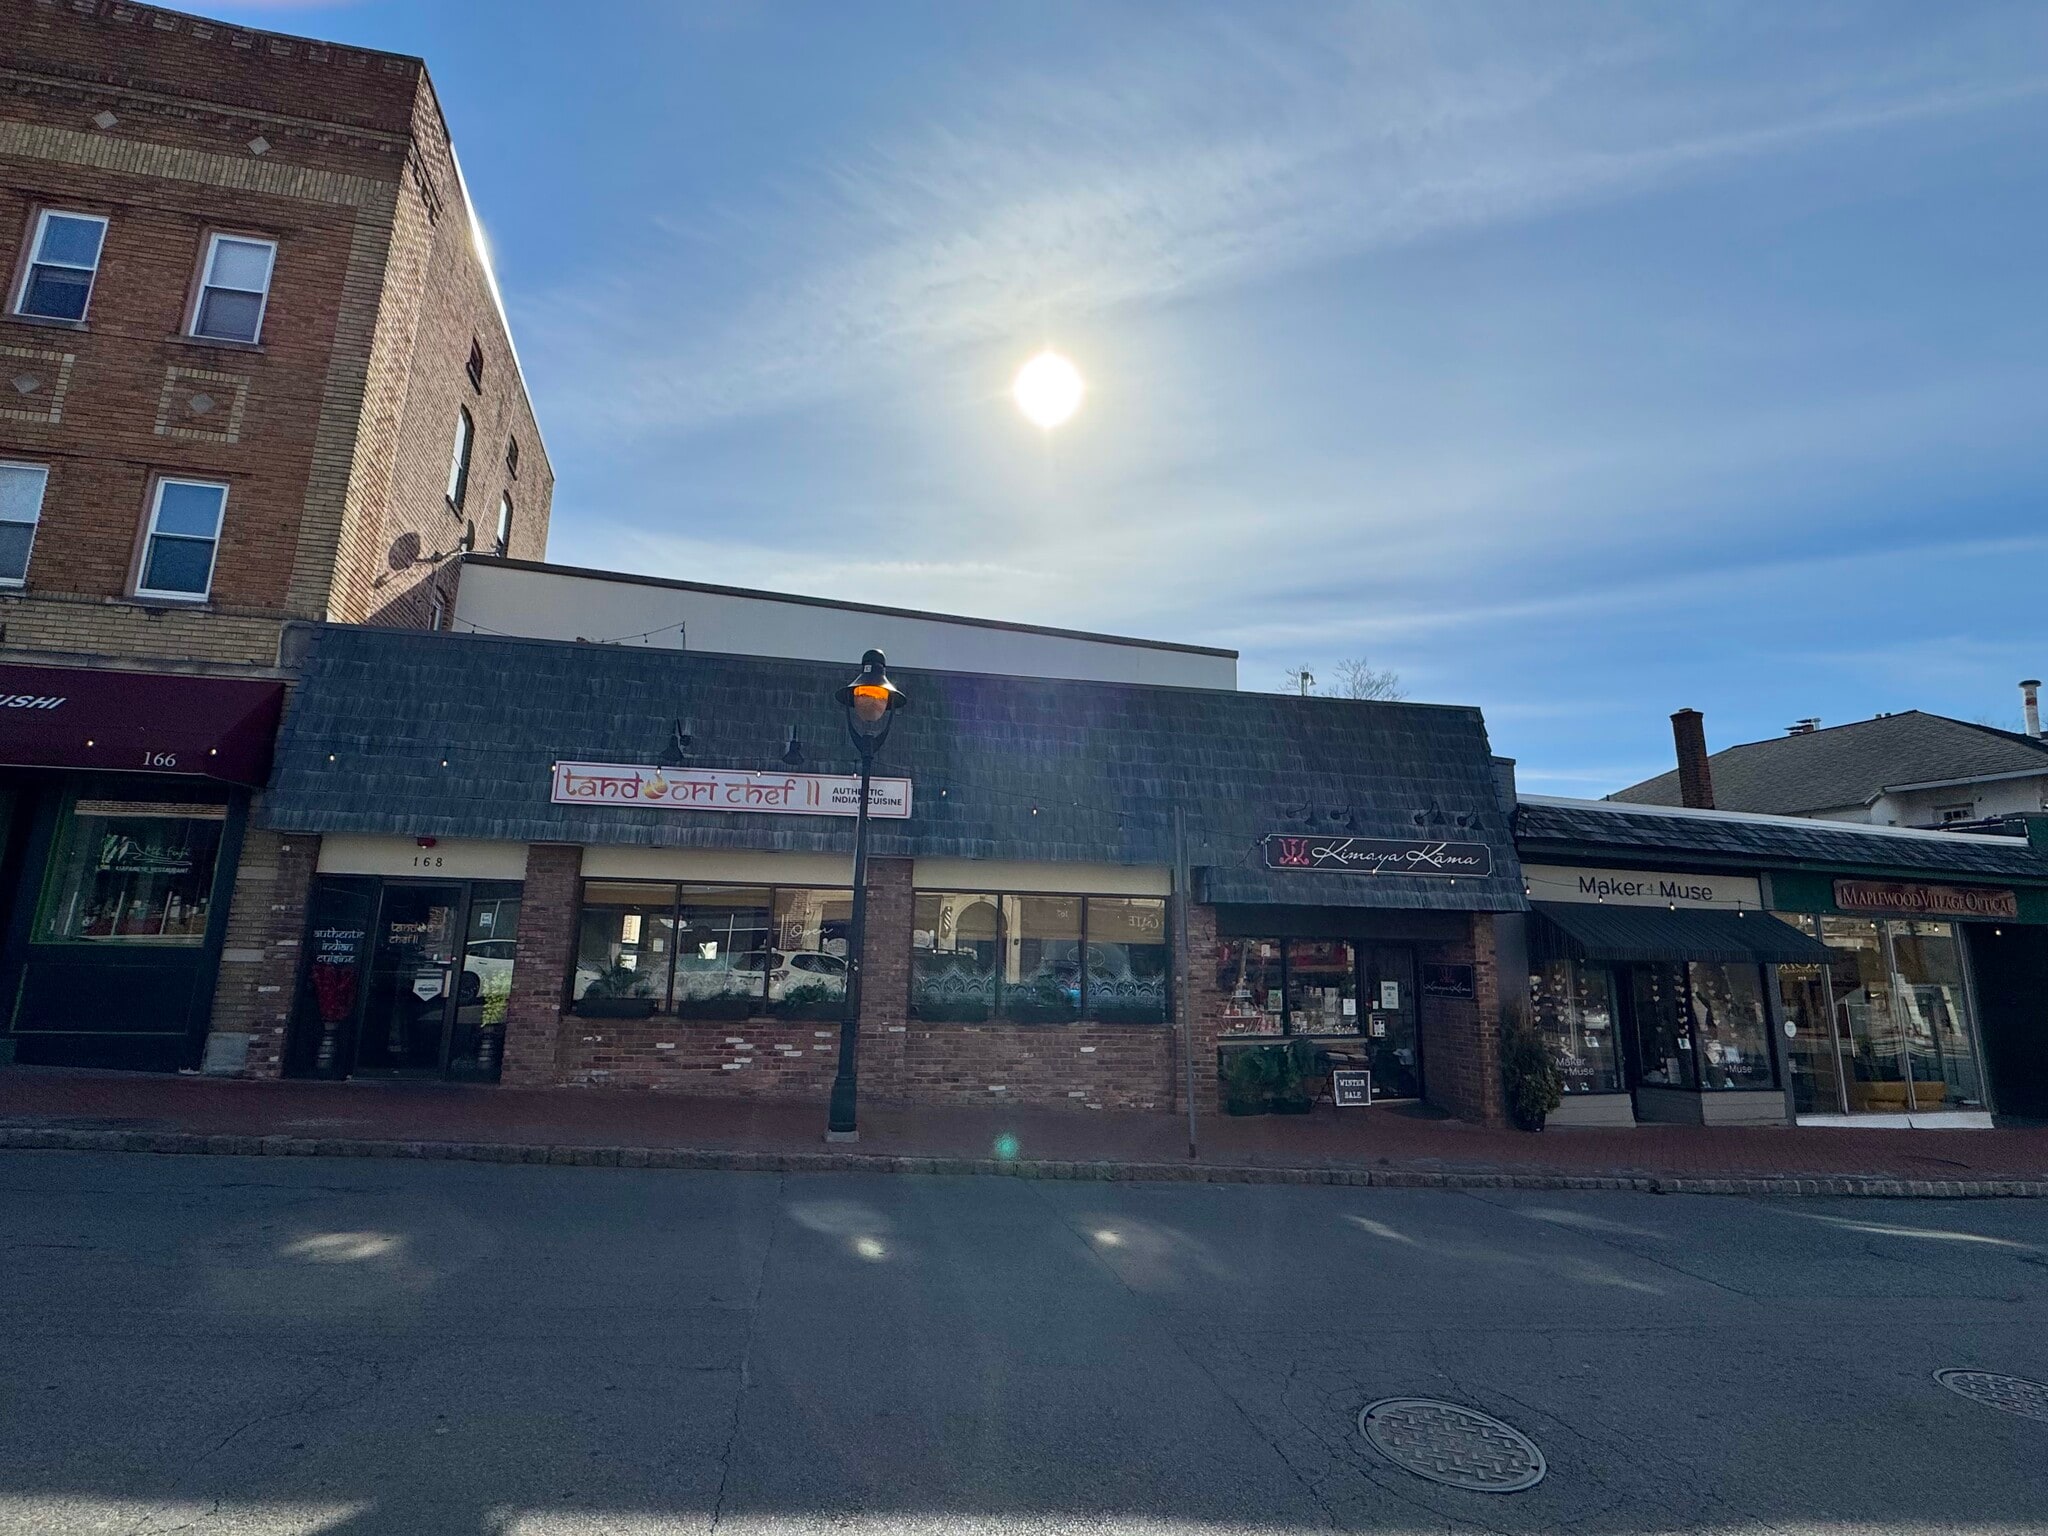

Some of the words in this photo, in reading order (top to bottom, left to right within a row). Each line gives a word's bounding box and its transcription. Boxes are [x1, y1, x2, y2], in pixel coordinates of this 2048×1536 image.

[142, 751, 177, 767] 166
[725, 776, 797, 806] chef
[866, 797, 903, 806] CUISINE
[1311, 838, 1404, 871] Kimaya
[412, 856, 444, 868] 168
[1578, 876, 1645, 896] Maker
[1659, 880, 1713, 901] Muse
[1841, 884, 1919, 908] MAPLEWOOD
[1919, 889, 1965, 911] VILLAGE
[1965, 892, 2014, 913] OPTICAL
[313, 926, 366, 939] authentic
[790, 924, 834, 944] Open
[321, 939, 354, 952] indian
[316, 952, 356, 965] cuisine
[1556, 1057, 1587, 1067] Maker
[1339, 1079, 1366, 1087] WINTER
[1344, 1091, 1362, 1099] SALE
